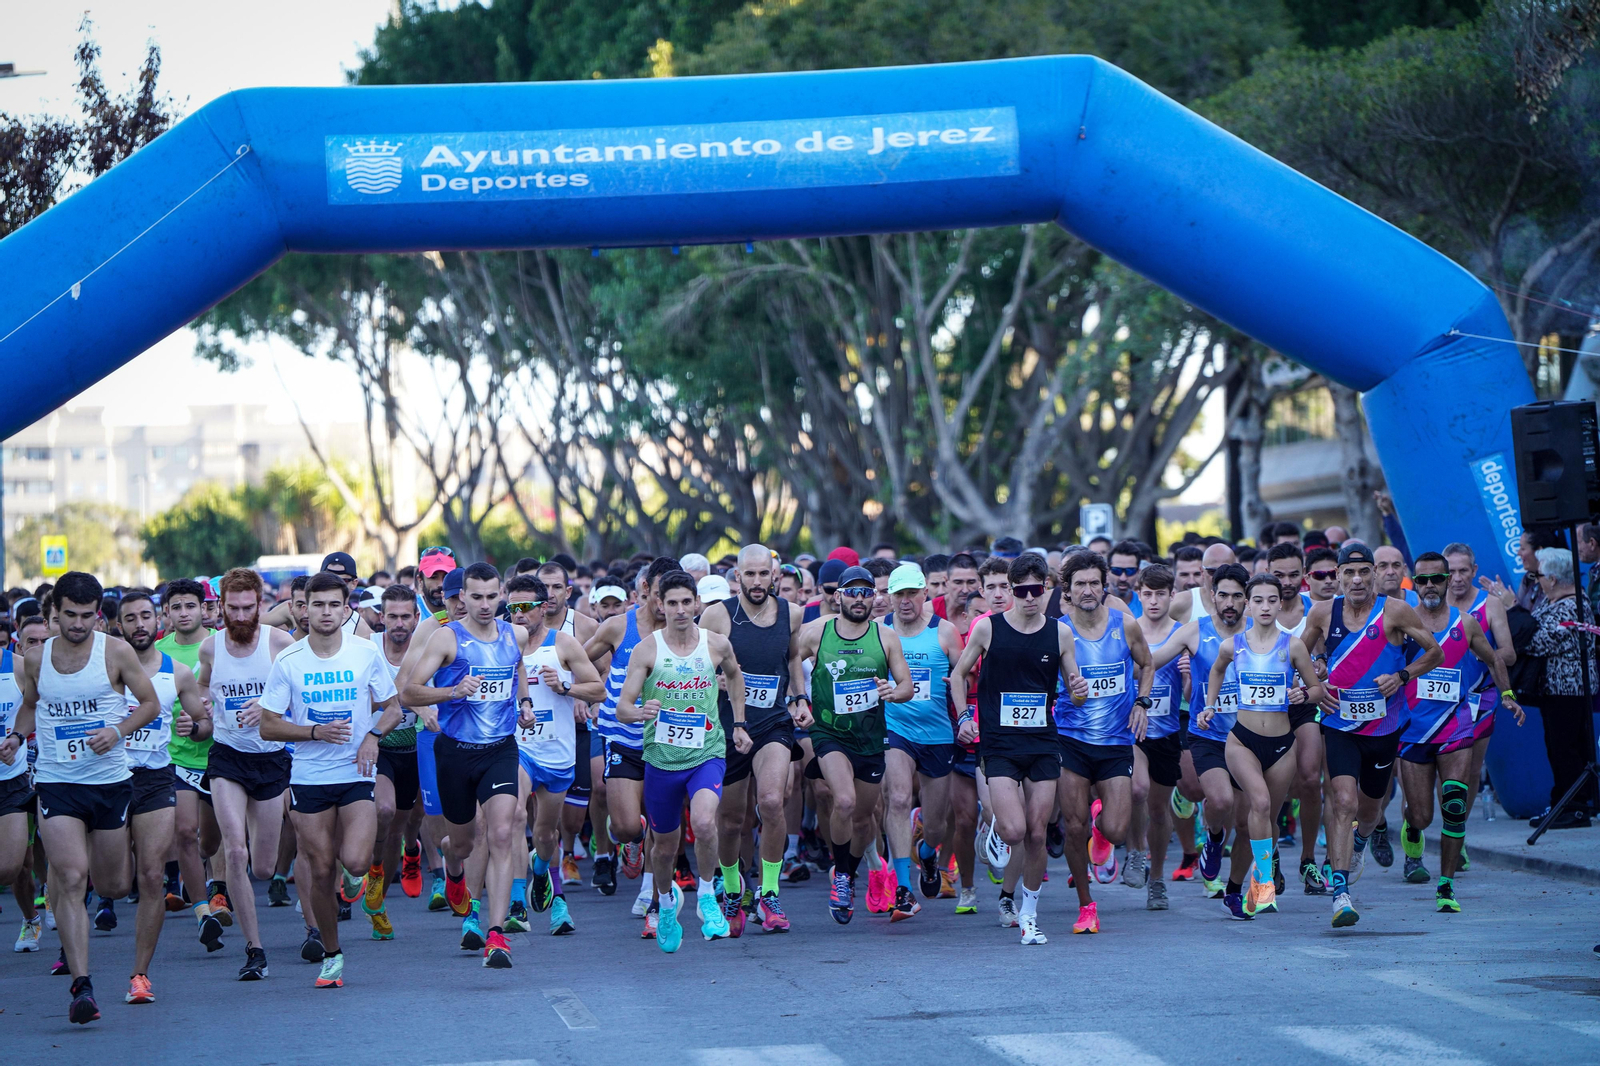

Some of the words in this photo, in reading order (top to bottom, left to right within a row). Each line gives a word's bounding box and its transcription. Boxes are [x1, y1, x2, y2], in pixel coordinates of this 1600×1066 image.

[420, 136, 781, 172] Ayuntamiento
[795, 131, 854, 153] de
[867, 126, 996, 155] Jerez
[420, 173, 589, 193] Deportes
[1089, 510, 1105, 533] P
[304, 670, 354, 686] PABLO
[656, 675, 712, 690] maratón
[1092, 678, 1116, 690] 405
[222, 682, 266, 698] CHAPIN
[480, 681, 504, 693] 861
[745, 687, 767, 701] 518
[1249, 686, 1275, 698] 739
[1427, 681, 1450, 694] 370
[301, 687, 357, 704] SONRIE
[845, 692, 868, 706] 821
[0, 702, 13, 711] IP
[48, 699, 97, 717] CHAPIN
[1012, 707, 1037, 719] 827
[1350, 702, 1375, 714] 888
[668, 726, 693, 740] 575
[456, 742, 485, 750] NIKE
